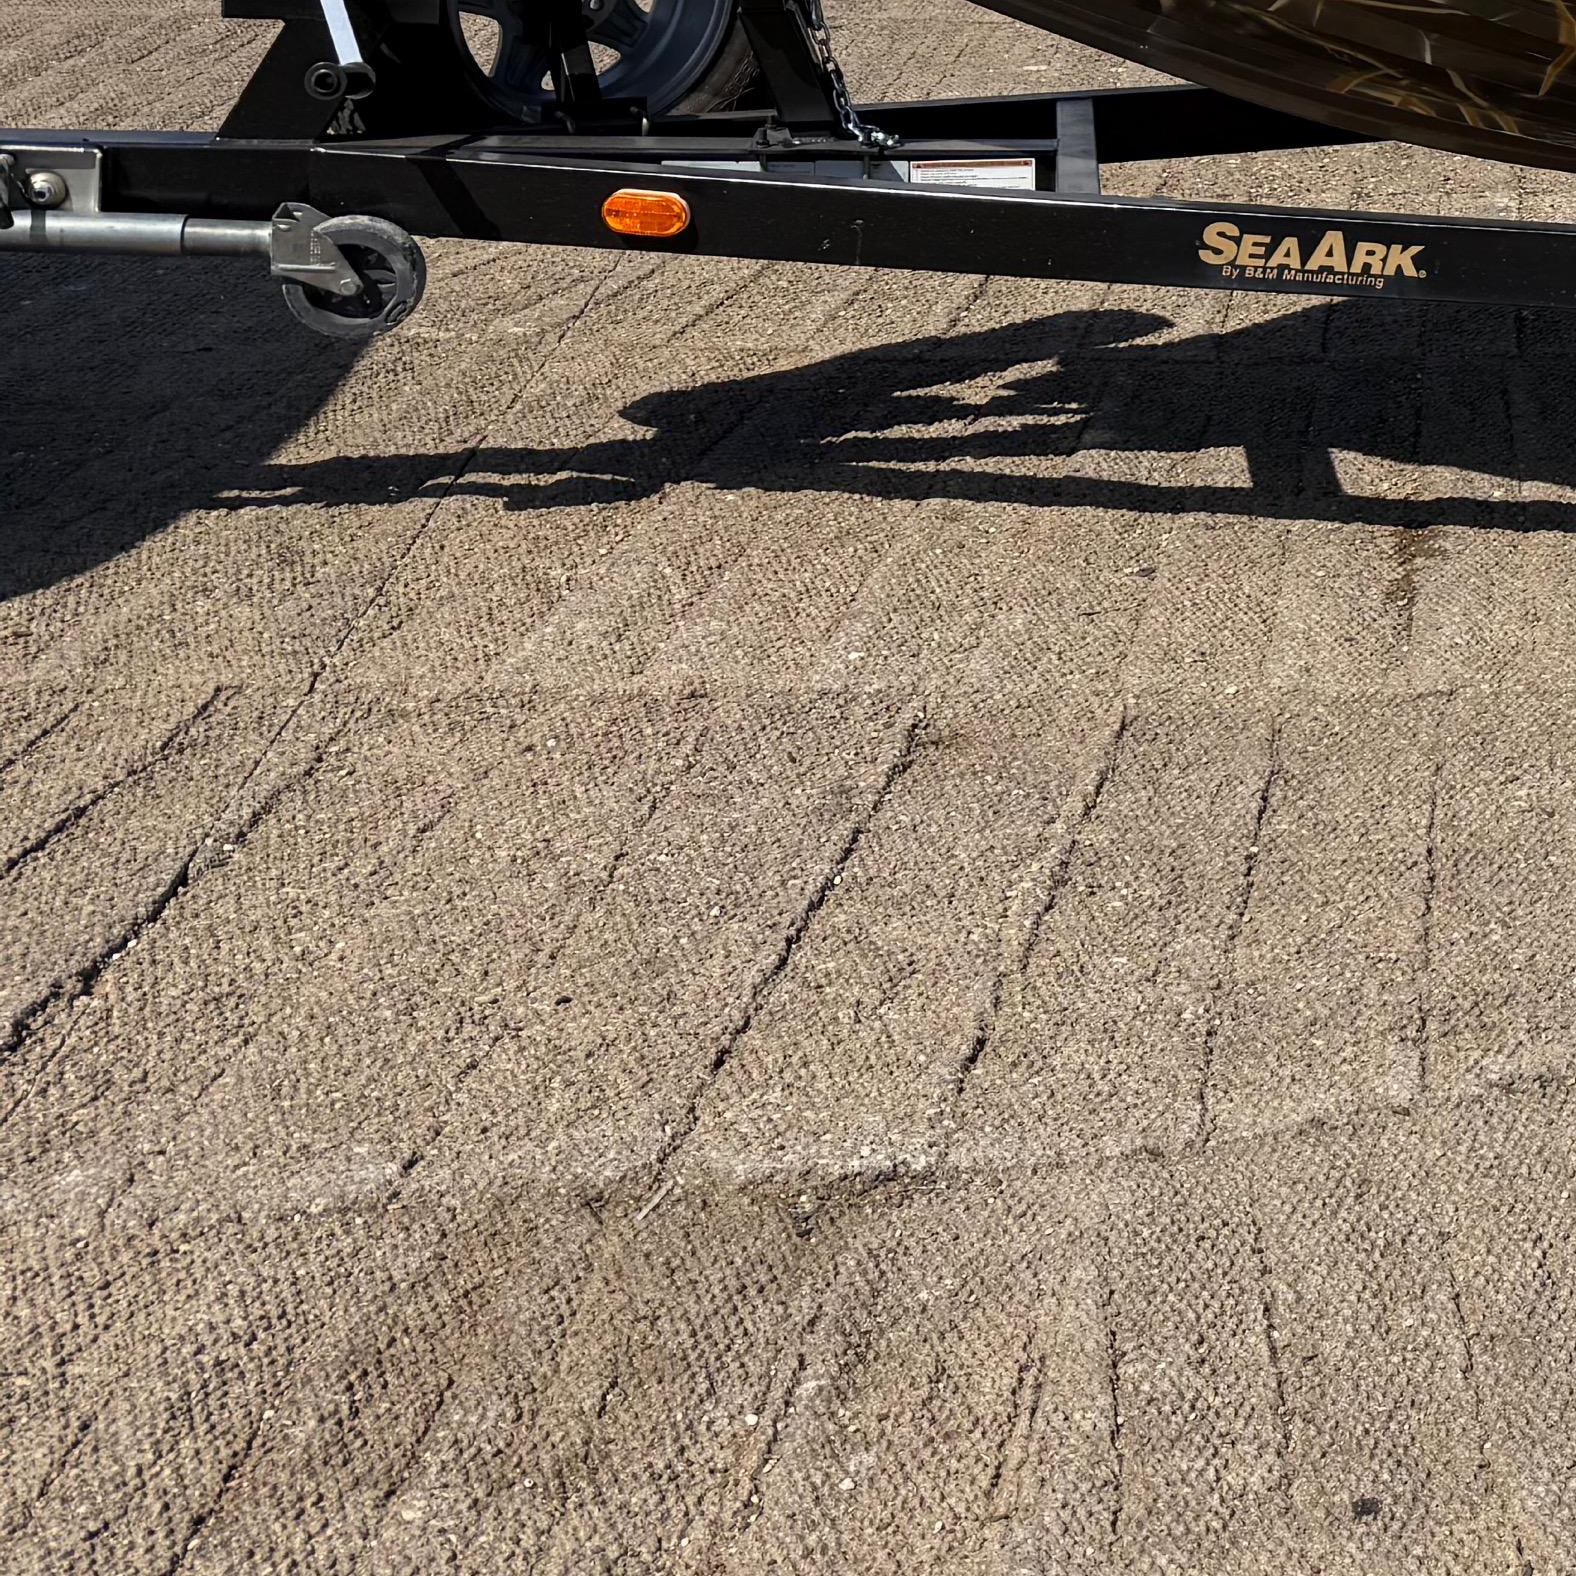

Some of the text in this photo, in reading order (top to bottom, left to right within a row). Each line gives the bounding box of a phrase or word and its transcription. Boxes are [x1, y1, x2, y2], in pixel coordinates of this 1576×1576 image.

[1221, 265, 1385, 290] By B&M Manufacturing
